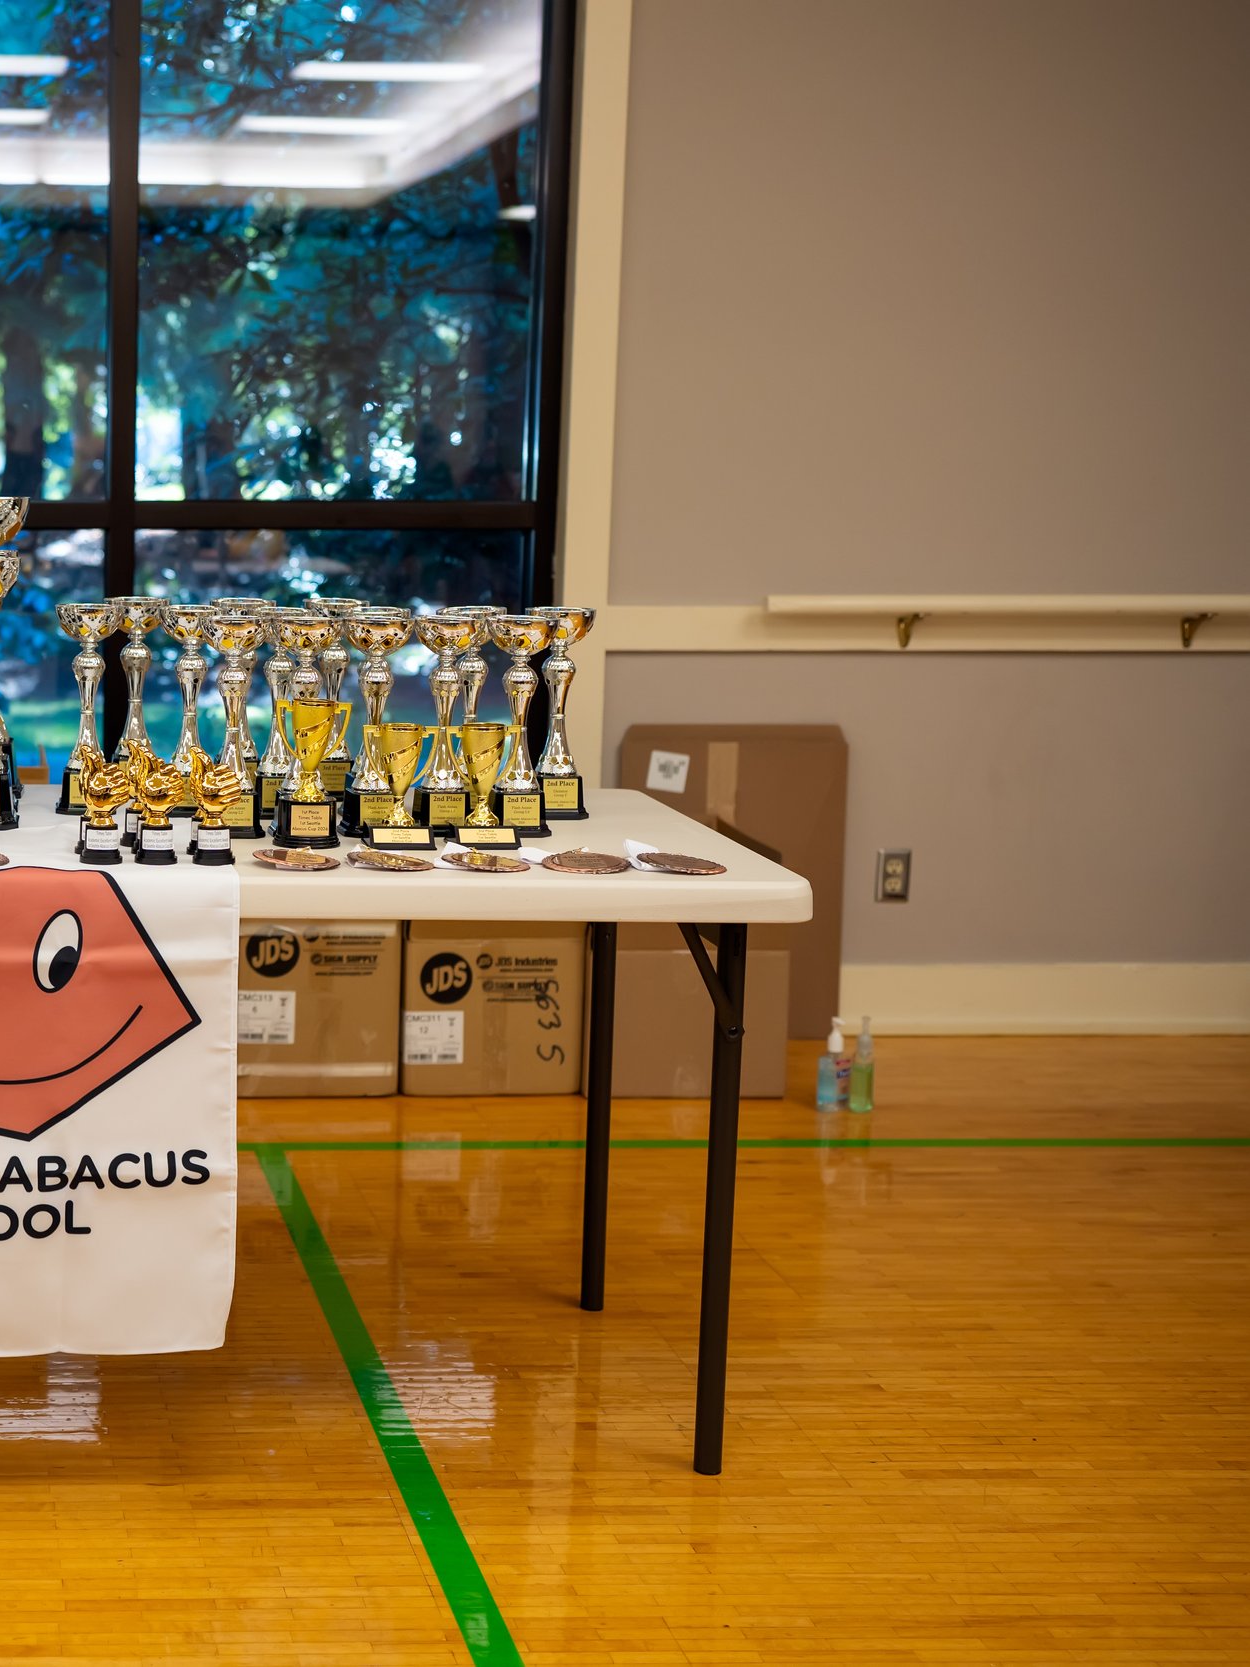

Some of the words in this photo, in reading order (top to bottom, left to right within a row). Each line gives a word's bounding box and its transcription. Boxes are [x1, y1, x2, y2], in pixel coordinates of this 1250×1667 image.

[252, 934, 294, 968] JDS
[495, 958, 512, 966] JDS
[515, 958, 557, 966] Industries
[425, 961, 467, 995] JDS
